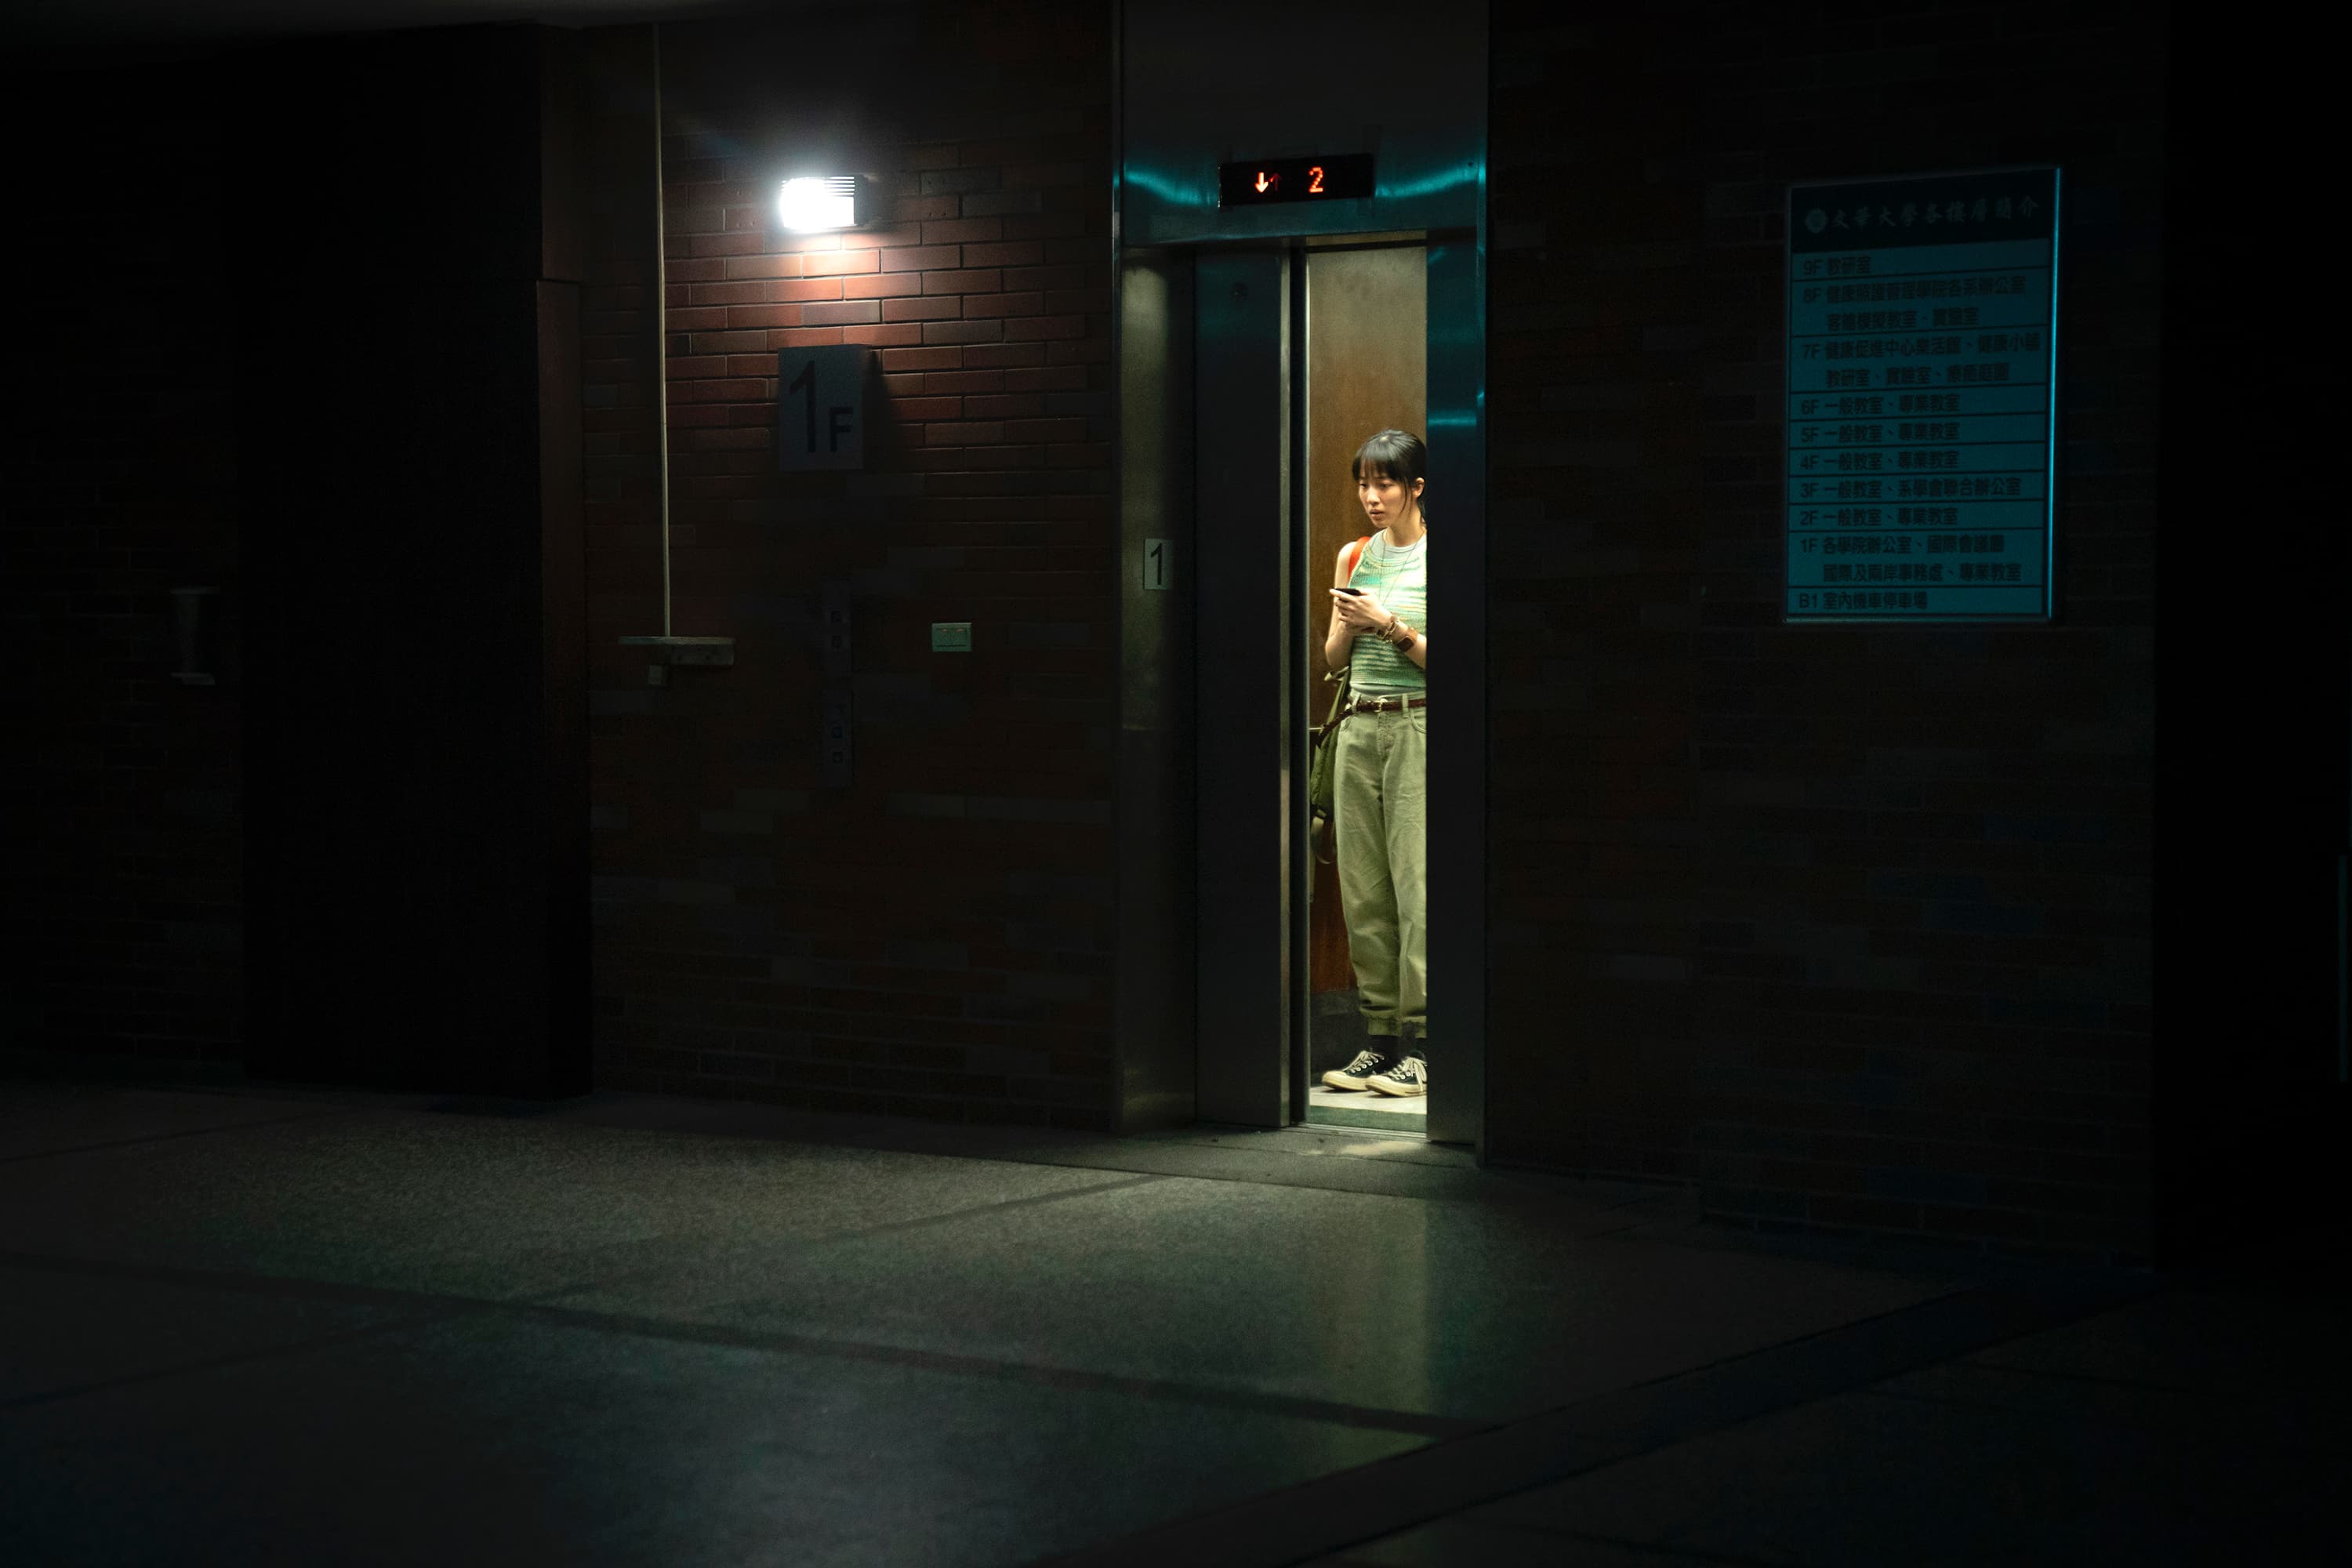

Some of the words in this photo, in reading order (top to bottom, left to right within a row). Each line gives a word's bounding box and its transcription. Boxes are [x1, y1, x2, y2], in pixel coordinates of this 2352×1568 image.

[1308, 165, 1325, 194] 2
[1802, 343, 1820, 360] 7F
[789, 360, 854, 453] 1F
[1800, 399, 1820, 415] 6F
[1800, 426, 1820, 443] 5F
[1799, 454, 1819, 470] 4F
[1799, 482, 1819, 498] 3F
[1799, 510, 1819, 526] 2F
[1800, 538, 1819, 553] 1F
[1150, 543, 1162, 586] 1
[1798, 593, 1818, 608] B1
